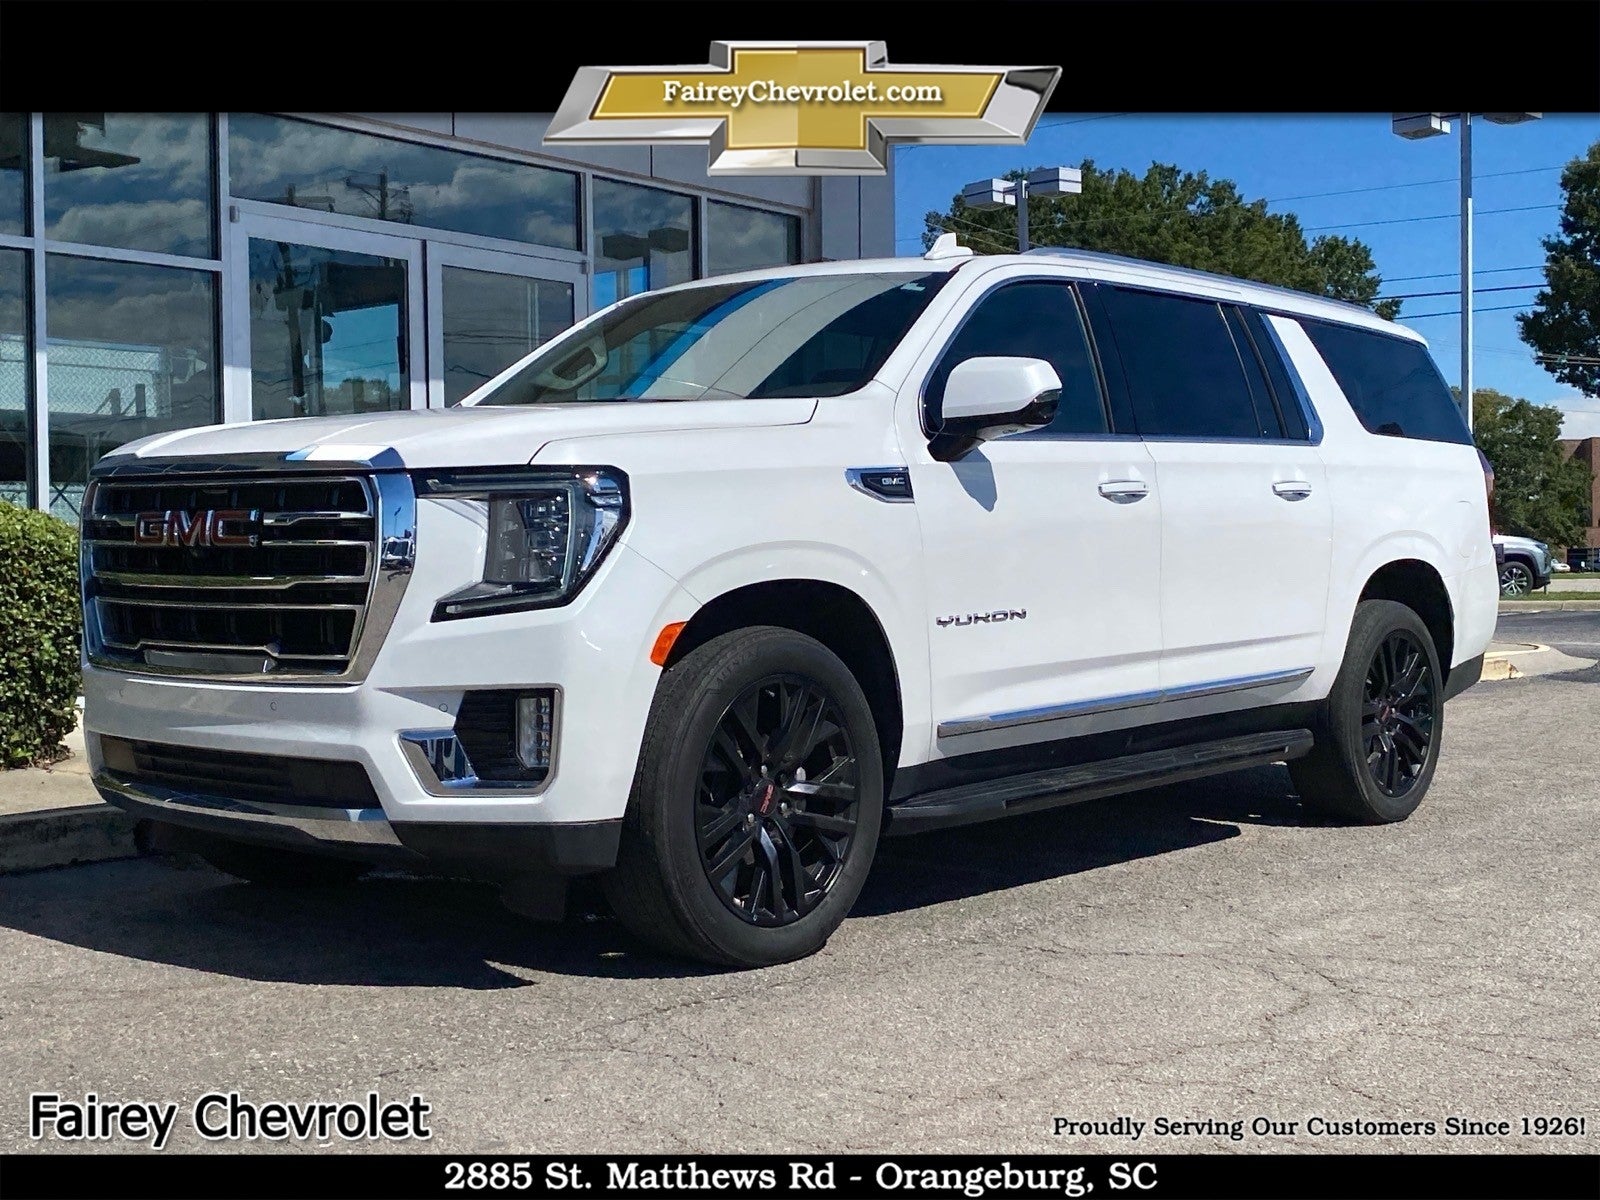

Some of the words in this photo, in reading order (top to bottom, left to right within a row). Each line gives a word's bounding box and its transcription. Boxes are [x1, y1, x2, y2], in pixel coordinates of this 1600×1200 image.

[882, 477, 905, 485] GMC
[135, 510, 258, 547] GMC
[936, 609, 1027, 627] YUKON
